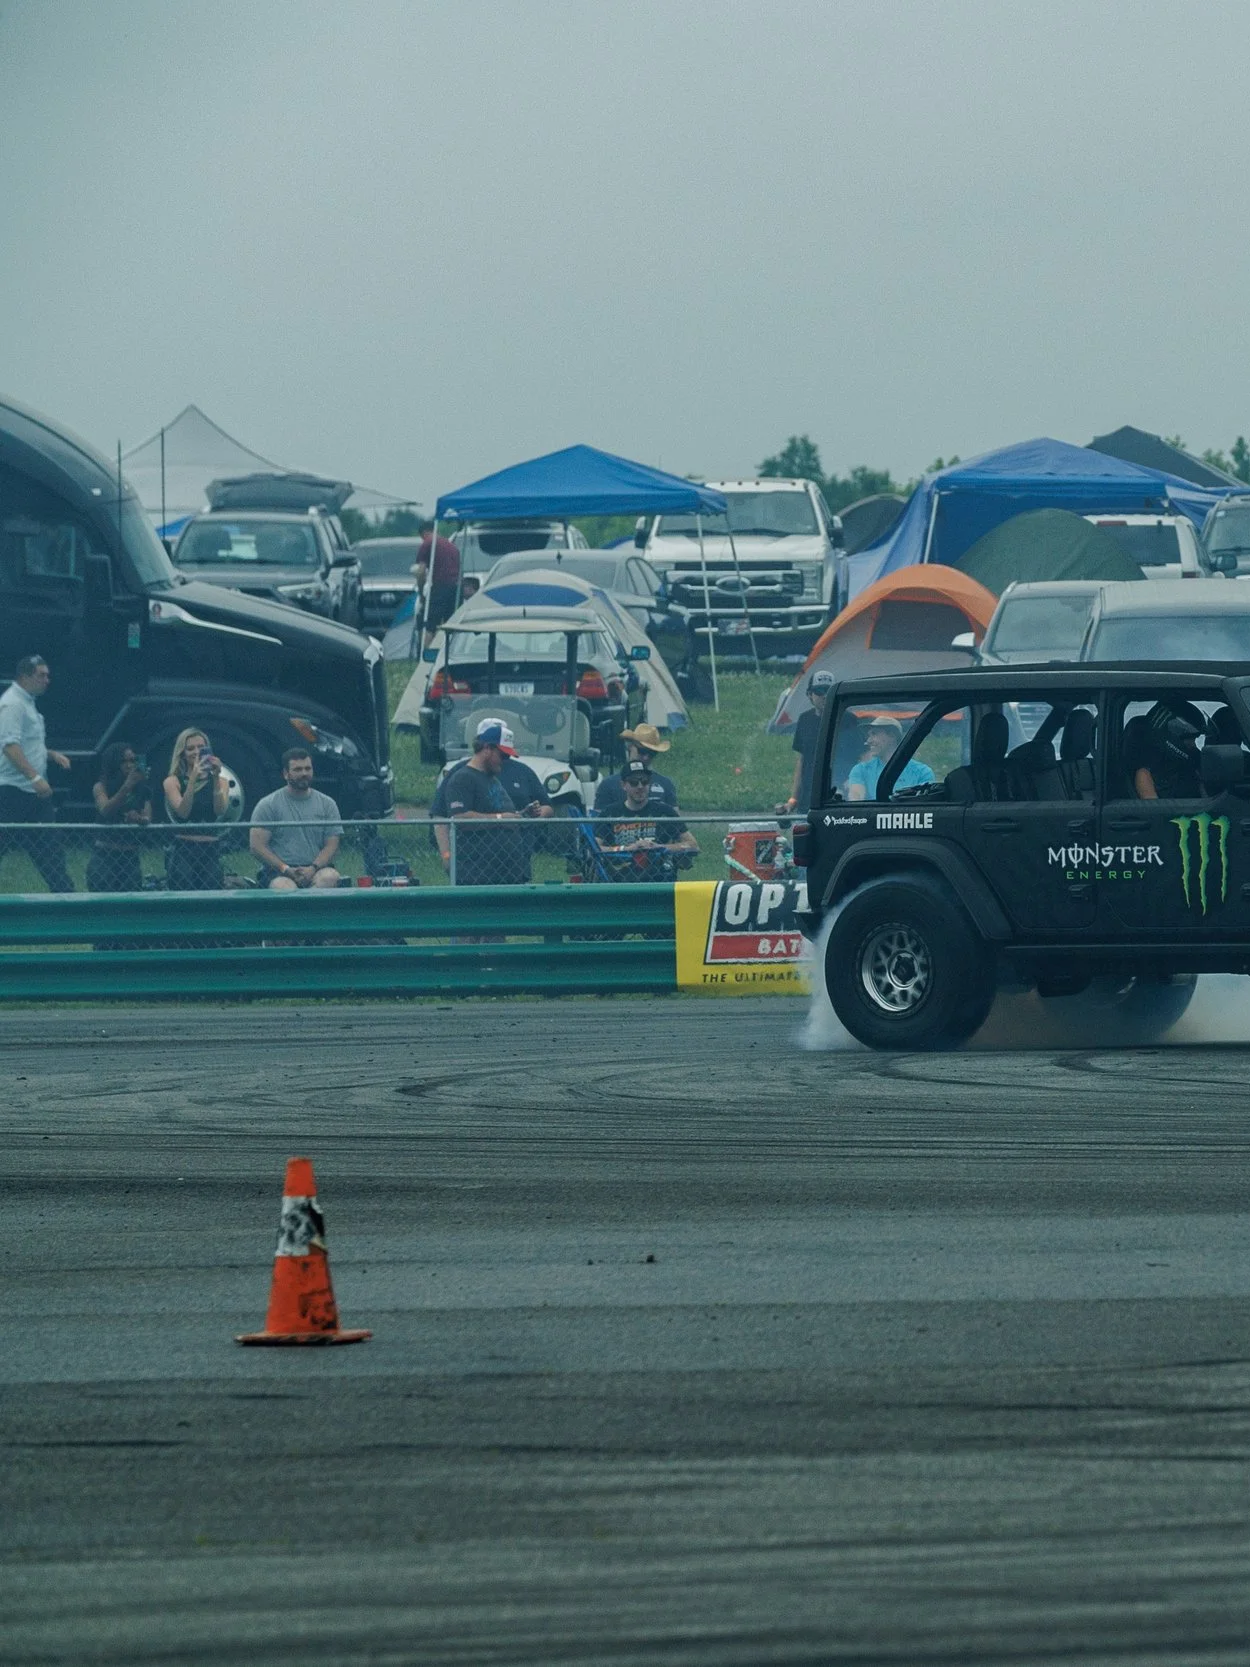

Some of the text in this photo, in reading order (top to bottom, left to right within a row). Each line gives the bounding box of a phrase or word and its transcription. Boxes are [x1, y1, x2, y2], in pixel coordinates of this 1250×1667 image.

[876, 813, 934, 829] MAHLE
[1047, 842, 1164, 869] MONSTER
[1066, 870, 1146, 880] ENERGY
[702, 973, 727, 983] THE
